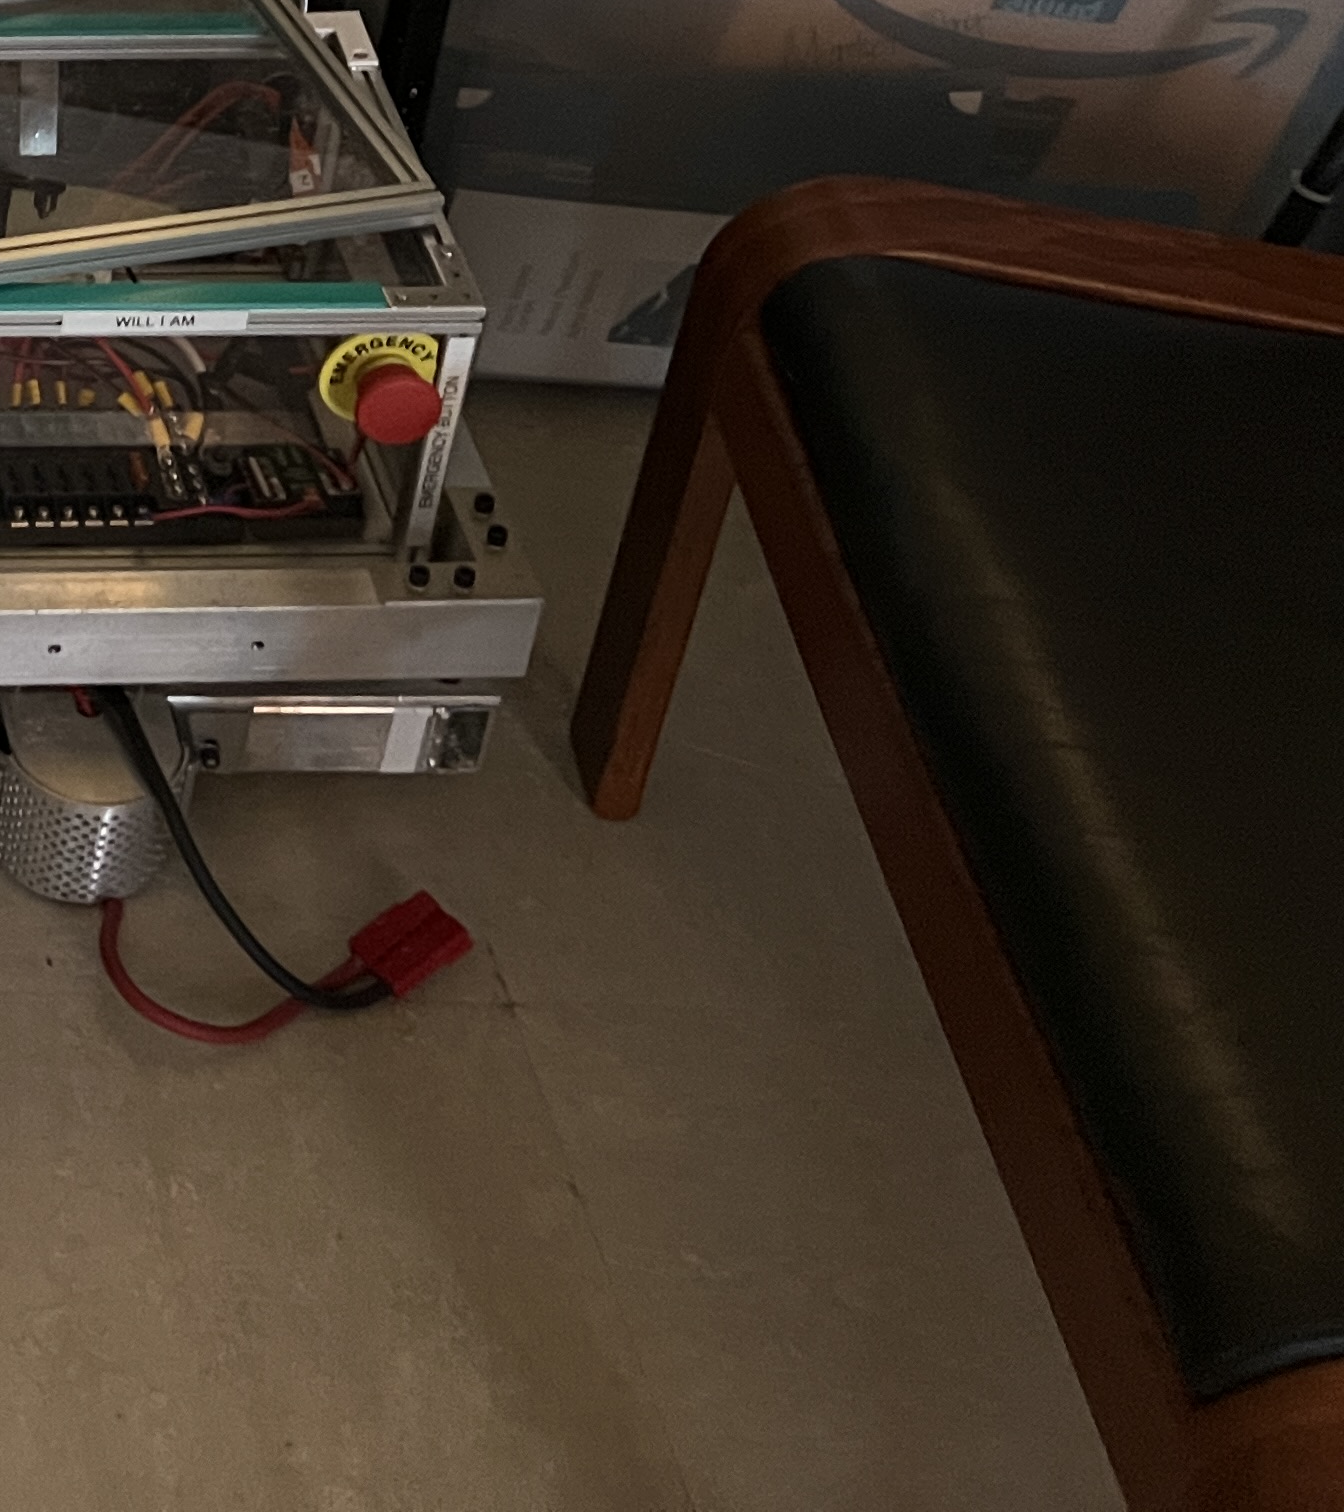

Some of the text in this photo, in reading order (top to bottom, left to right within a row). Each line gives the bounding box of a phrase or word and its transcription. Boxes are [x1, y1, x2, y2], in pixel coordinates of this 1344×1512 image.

[116, 315, 155, 327] WILL
[169, 314, 196, 327] AM
[328, 336, 435, 385] EMERGENCY
[418, 430, 448, 509] EMERGENCY
